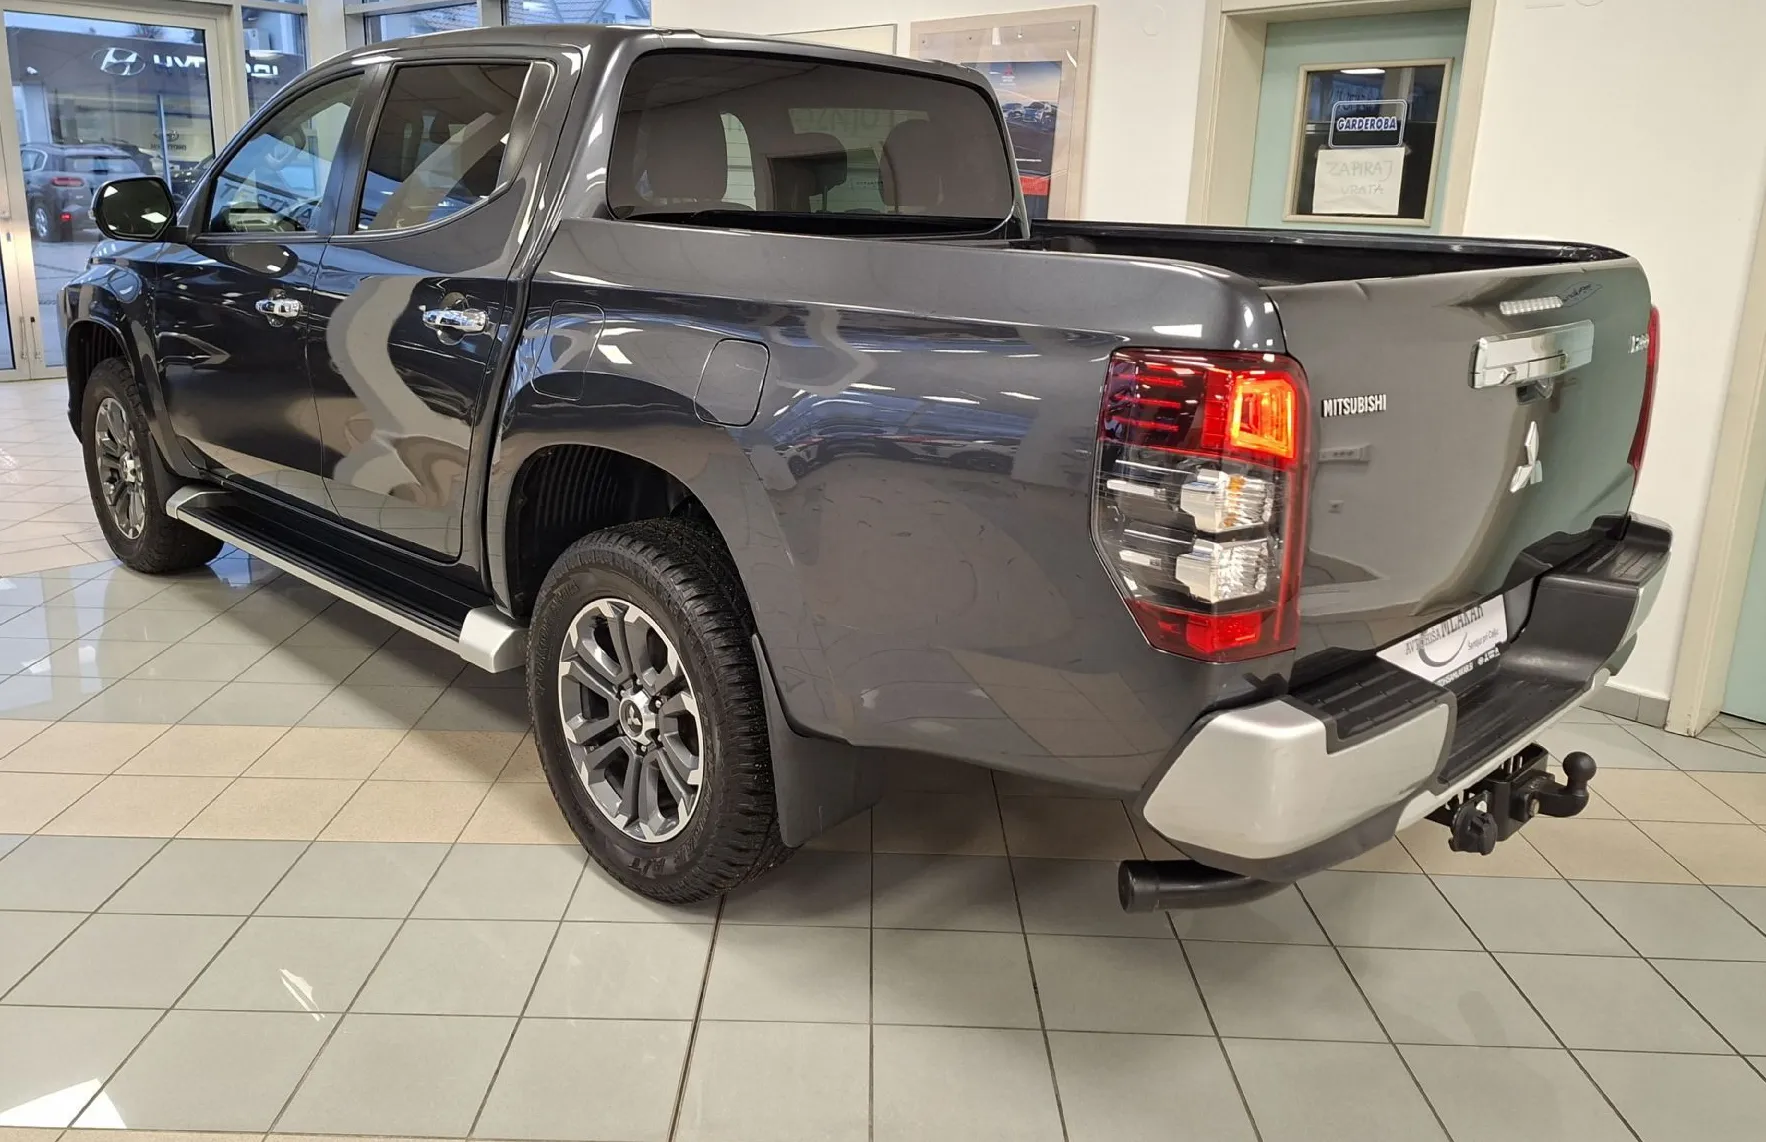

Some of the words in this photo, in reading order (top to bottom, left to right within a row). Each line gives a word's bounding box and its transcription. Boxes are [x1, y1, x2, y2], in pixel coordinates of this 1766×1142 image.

[153, 53, 279, 77] HYAI
[1337, 117, 1397, 131] GARDEROBA
[1326, 160, 1393, 181] ZAPIRAJ
[1321, 394, 1387, 418] MITSUBISHI
